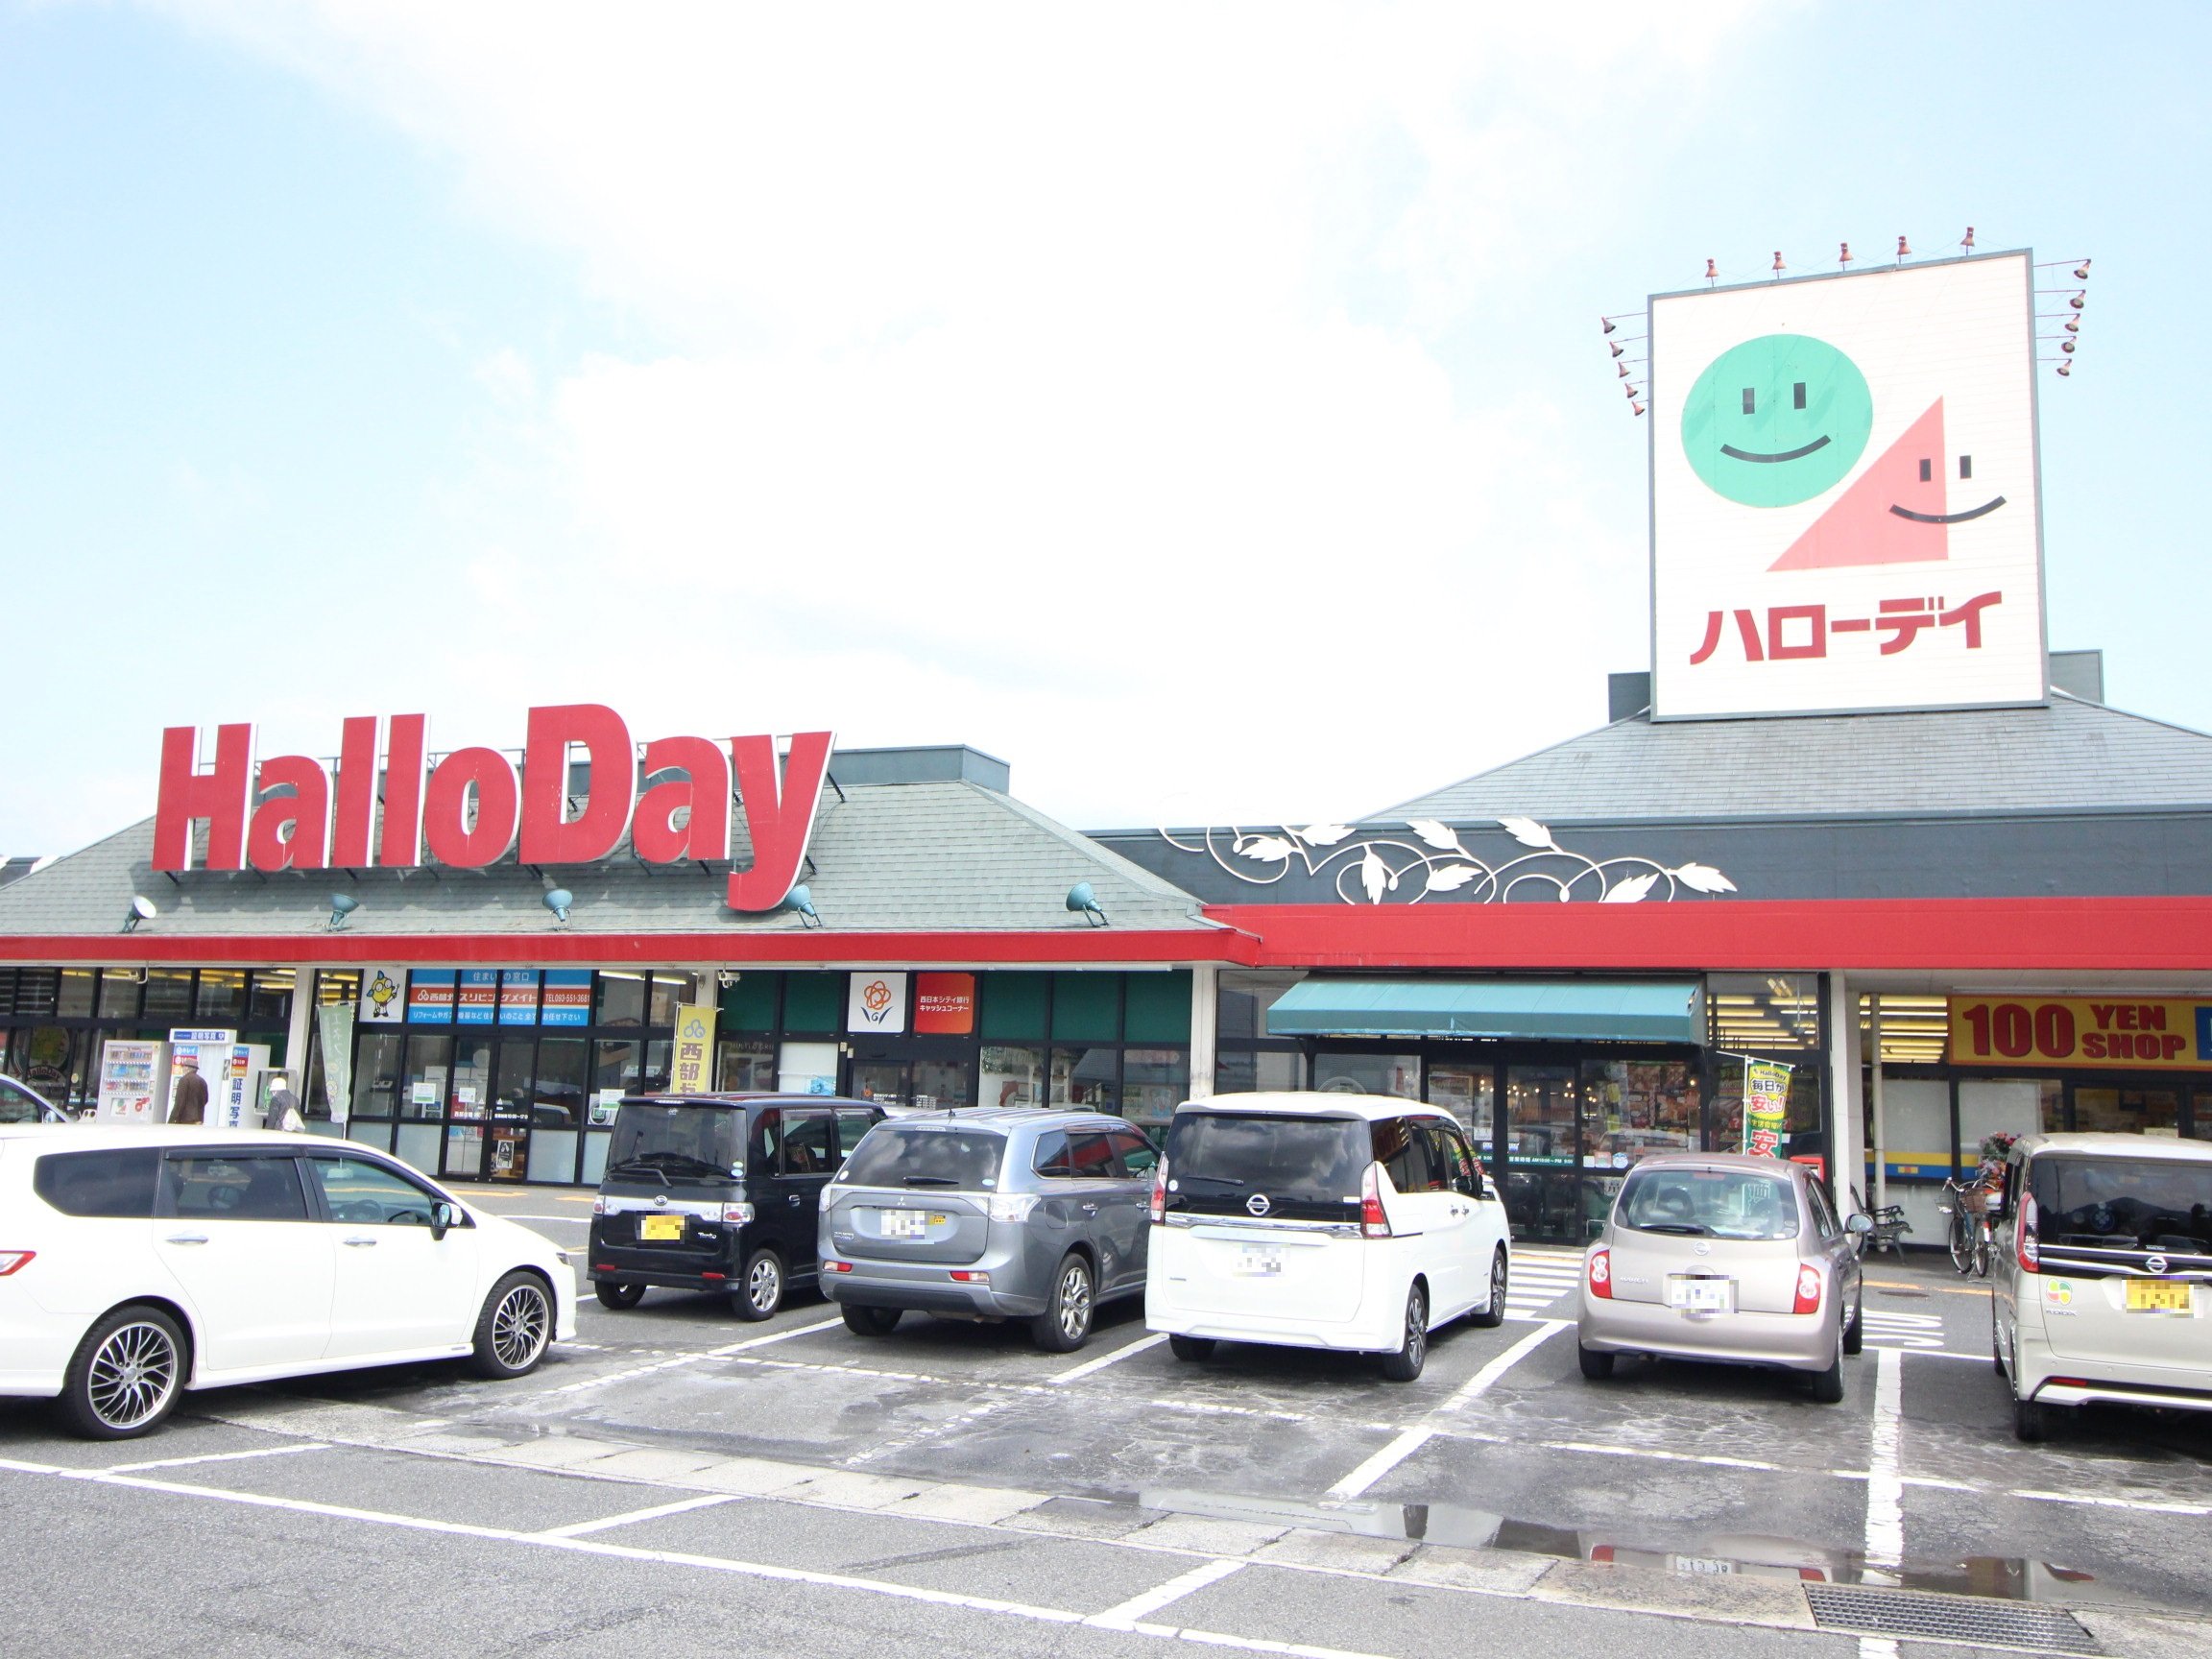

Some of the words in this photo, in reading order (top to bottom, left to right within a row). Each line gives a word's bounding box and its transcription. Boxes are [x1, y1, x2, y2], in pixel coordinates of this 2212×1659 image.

[152, 704, 837, 911] HalloDay
[1962, 1003, 2076, 1058] 100
[2090, 1004, 2167, 1030] YEN
[2081, 1032, 2187, 1060] SHOP
[1751, 1079, 1786, 1093] 毎日が
